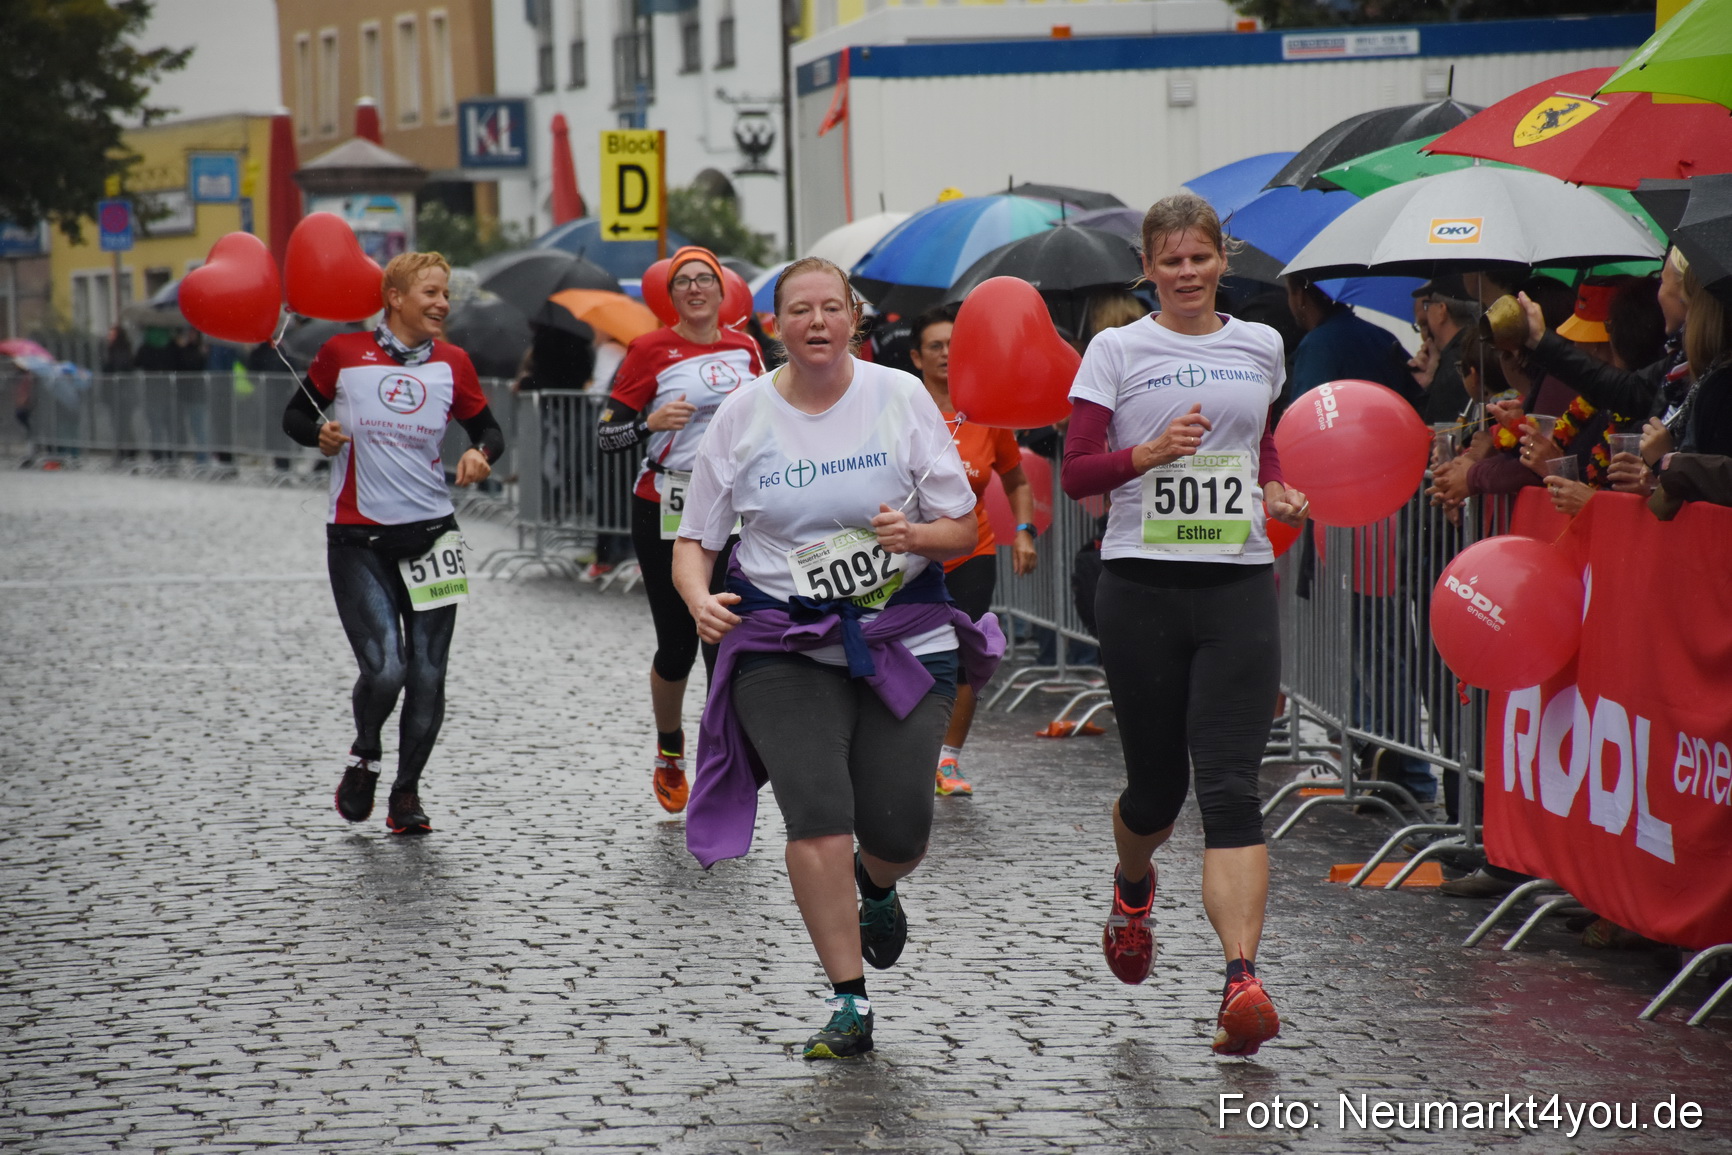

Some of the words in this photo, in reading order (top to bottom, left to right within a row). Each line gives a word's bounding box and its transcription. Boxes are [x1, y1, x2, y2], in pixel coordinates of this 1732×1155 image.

[607, 136, 659, 154] Block
[618, 164, 649, 214] D
[1437, 226, 1475, 235] DKV
[1147, 374, 1172, 389] FeG
[1192, 455, 1242, 467] BOCK
[759, 471, 780, 489] FeG
[821, 452, 888, 476] NEUMARKT
[1154, 476, 1243, 515] 5012
[1146, 511, 1152, 519] S
[1177, 525, 1222, 540] Esther
[797, 548, 831, 566] NeuerMarkt
[408, 549, 466, 584] 5195
[806, 544, 900, 602] 5092
[429, 583, 465, 598] Nadine
[1466, 604, 1501, 632] energie
